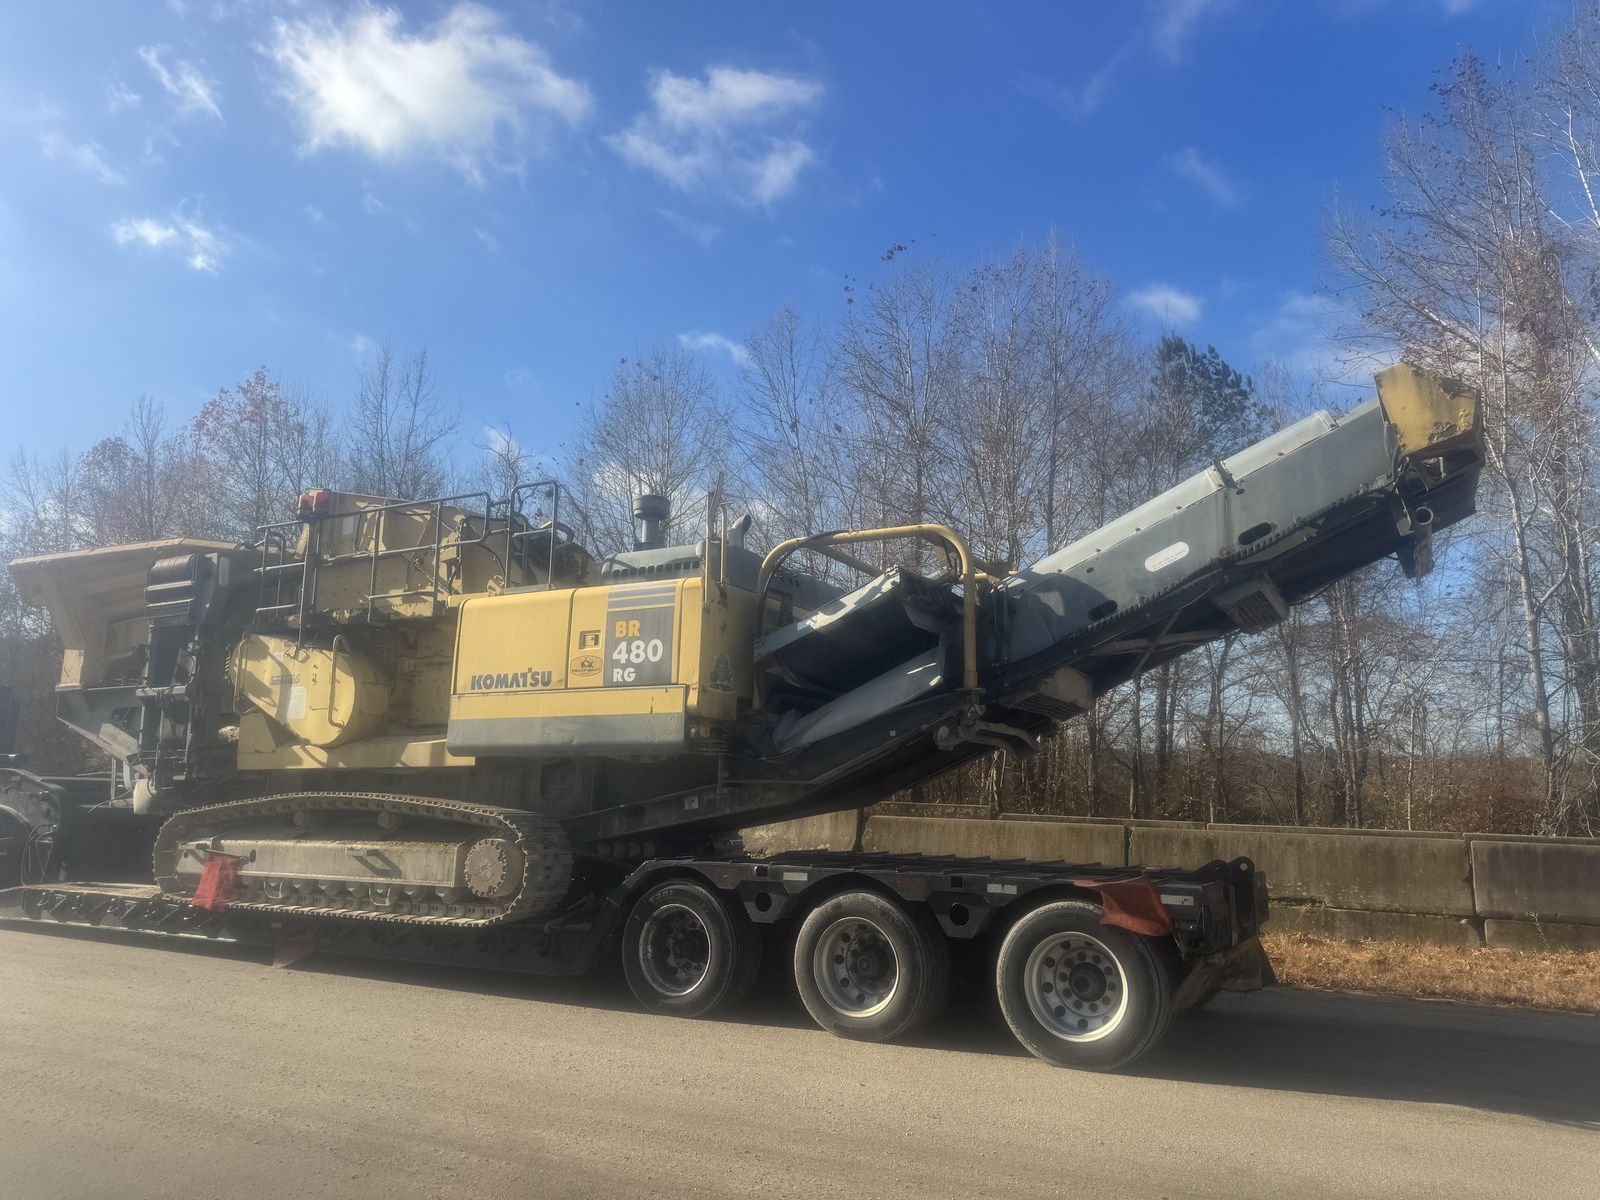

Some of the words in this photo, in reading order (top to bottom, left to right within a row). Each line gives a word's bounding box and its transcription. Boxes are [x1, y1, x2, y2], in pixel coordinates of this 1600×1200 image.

[615, 620, 640, 638] BR
[612, 638, 663, 664] 480
[470, 667, 552, 691] KOMATSU
[612, 667, 636, 683] RG
